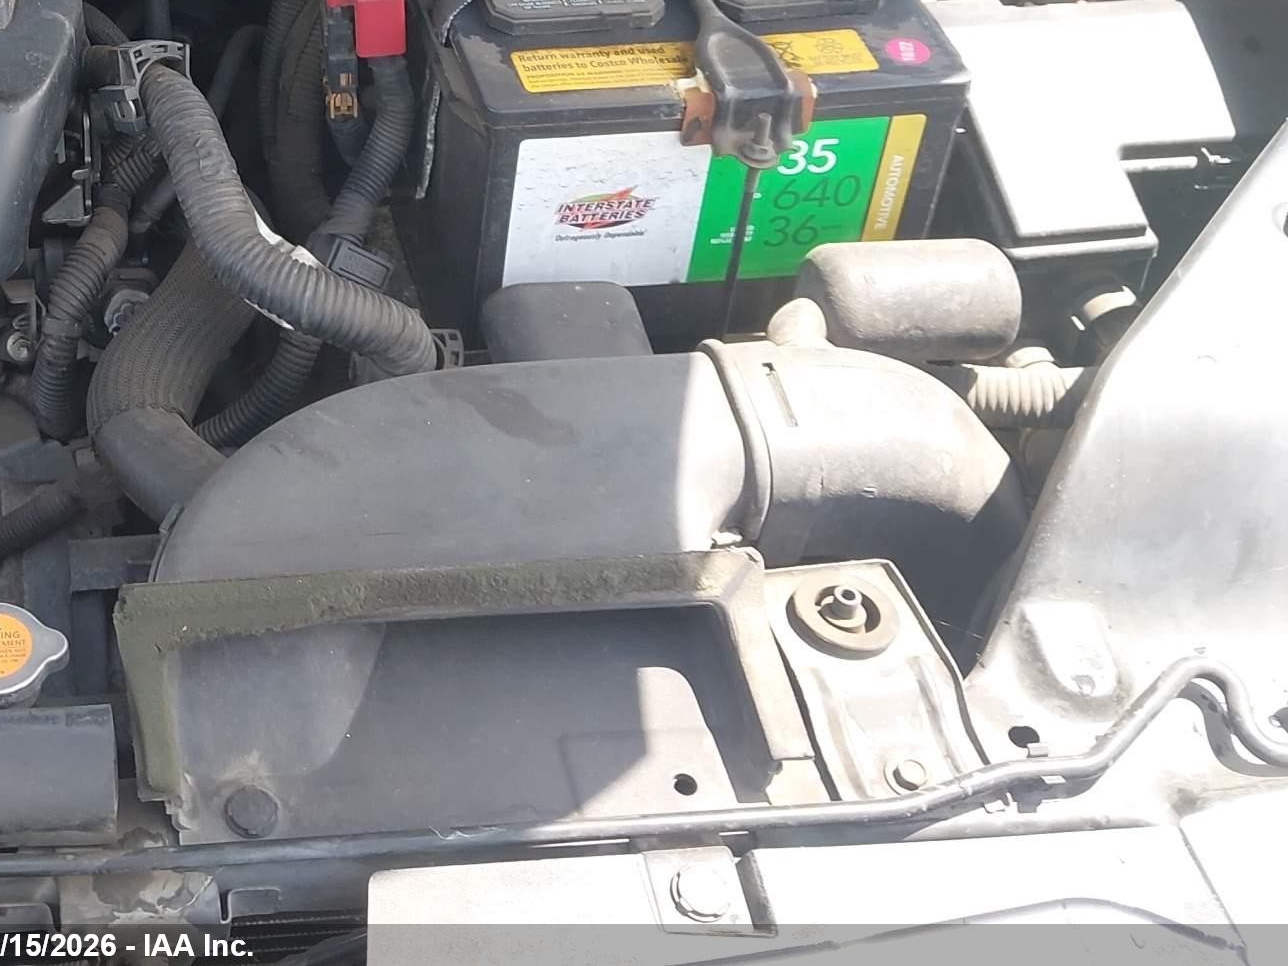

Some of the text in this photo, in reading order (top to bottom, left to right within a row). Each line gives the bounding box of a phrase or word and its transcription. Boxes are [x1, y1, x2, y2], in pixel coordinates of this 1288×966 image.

[519, 46, 665, 63] Return warranty and used
[522, 62, 573, 72] batteries
[577, 61, 588, 69] to
[590, 58, 626, 68] Costco
[777, 138, 840, 175] 35
[773, 174, 861, 211] 640
[874, 154, 905, 230] AUTOMOTIVE
[558, 198, 656, 213] INTERSTATE
[560, 210, 647, 223] BATTERIES
